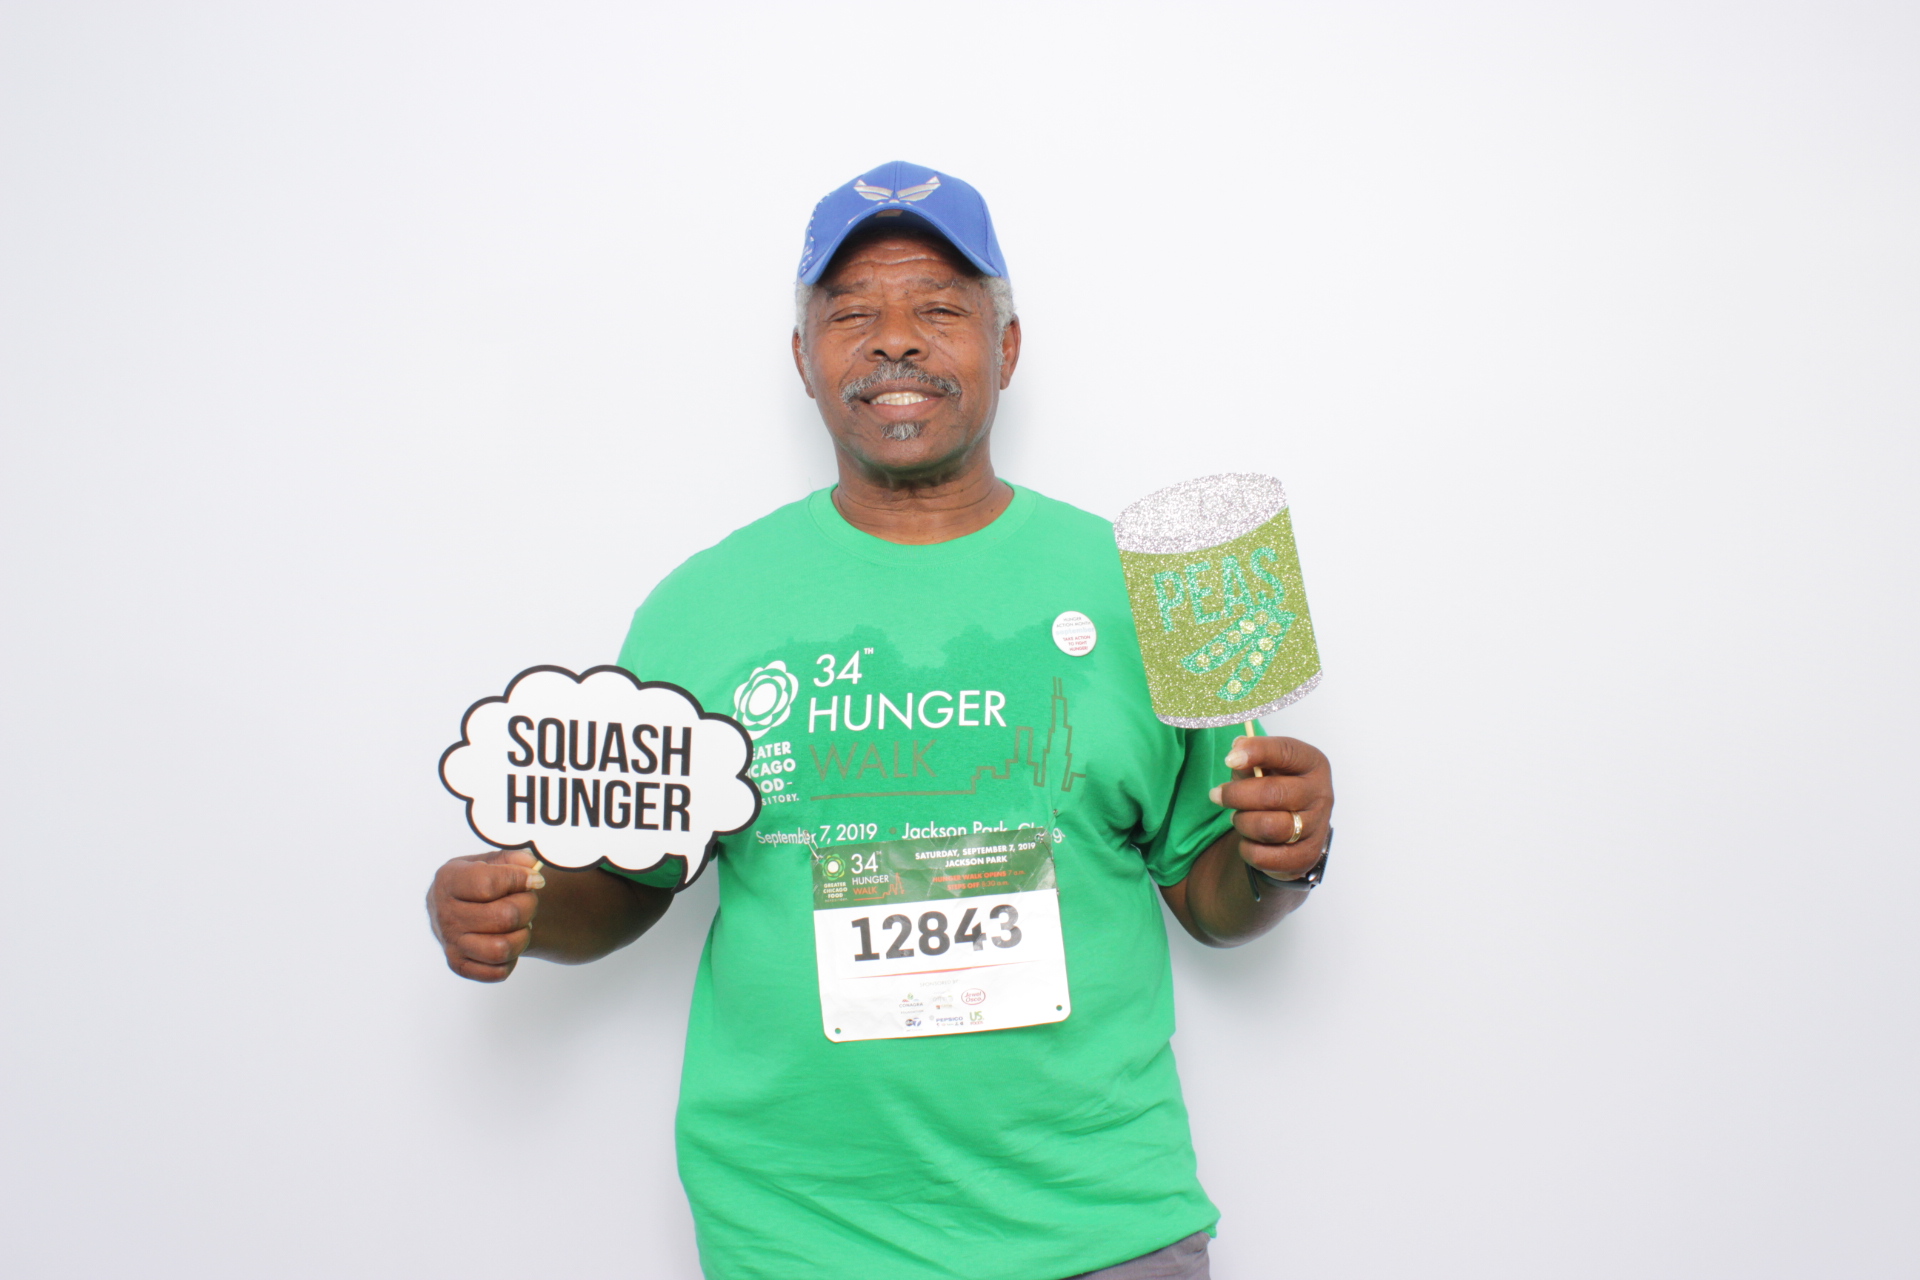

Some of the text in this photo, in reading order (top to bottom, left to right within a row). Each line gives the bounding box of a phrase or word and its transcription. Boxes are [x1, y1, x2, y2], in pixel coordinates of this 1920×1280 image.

[1153, 546, 1285, 633] PEAS
[808, 689, 1007, 733] HUNGER
[507, 715, 692, 776] SQUASH
[808, 739, 937, 782] WALK
[507, 773, 692, 832] HUNGER
[755, 827, 817, 848] September
[836, 823, 878, 841] 2019
[902, 821, 967, 839] Jackson
[915, 849, 960, 860] SATURDAY,
[962, 845, 1008, 856] SEPTEMBER
[1018, 842, 1036, 851] 2019
[945, 855, 1008, 868] JACKSON PARK
[823, 881, 847, 889] GREATER
[851, 875, 889, 886] HUNGER
[932, 874, 964, 883] HUNGER
[963, 873, 983, 881] WALK
[984, 871, 1007, 879] OPENS
[853, 886, 878, 895] WALK
[947, 883, 966, 891] STEPS
[851, 904, 1022, 962] 12843
[919, 979, 952, 988] SPONSORED
